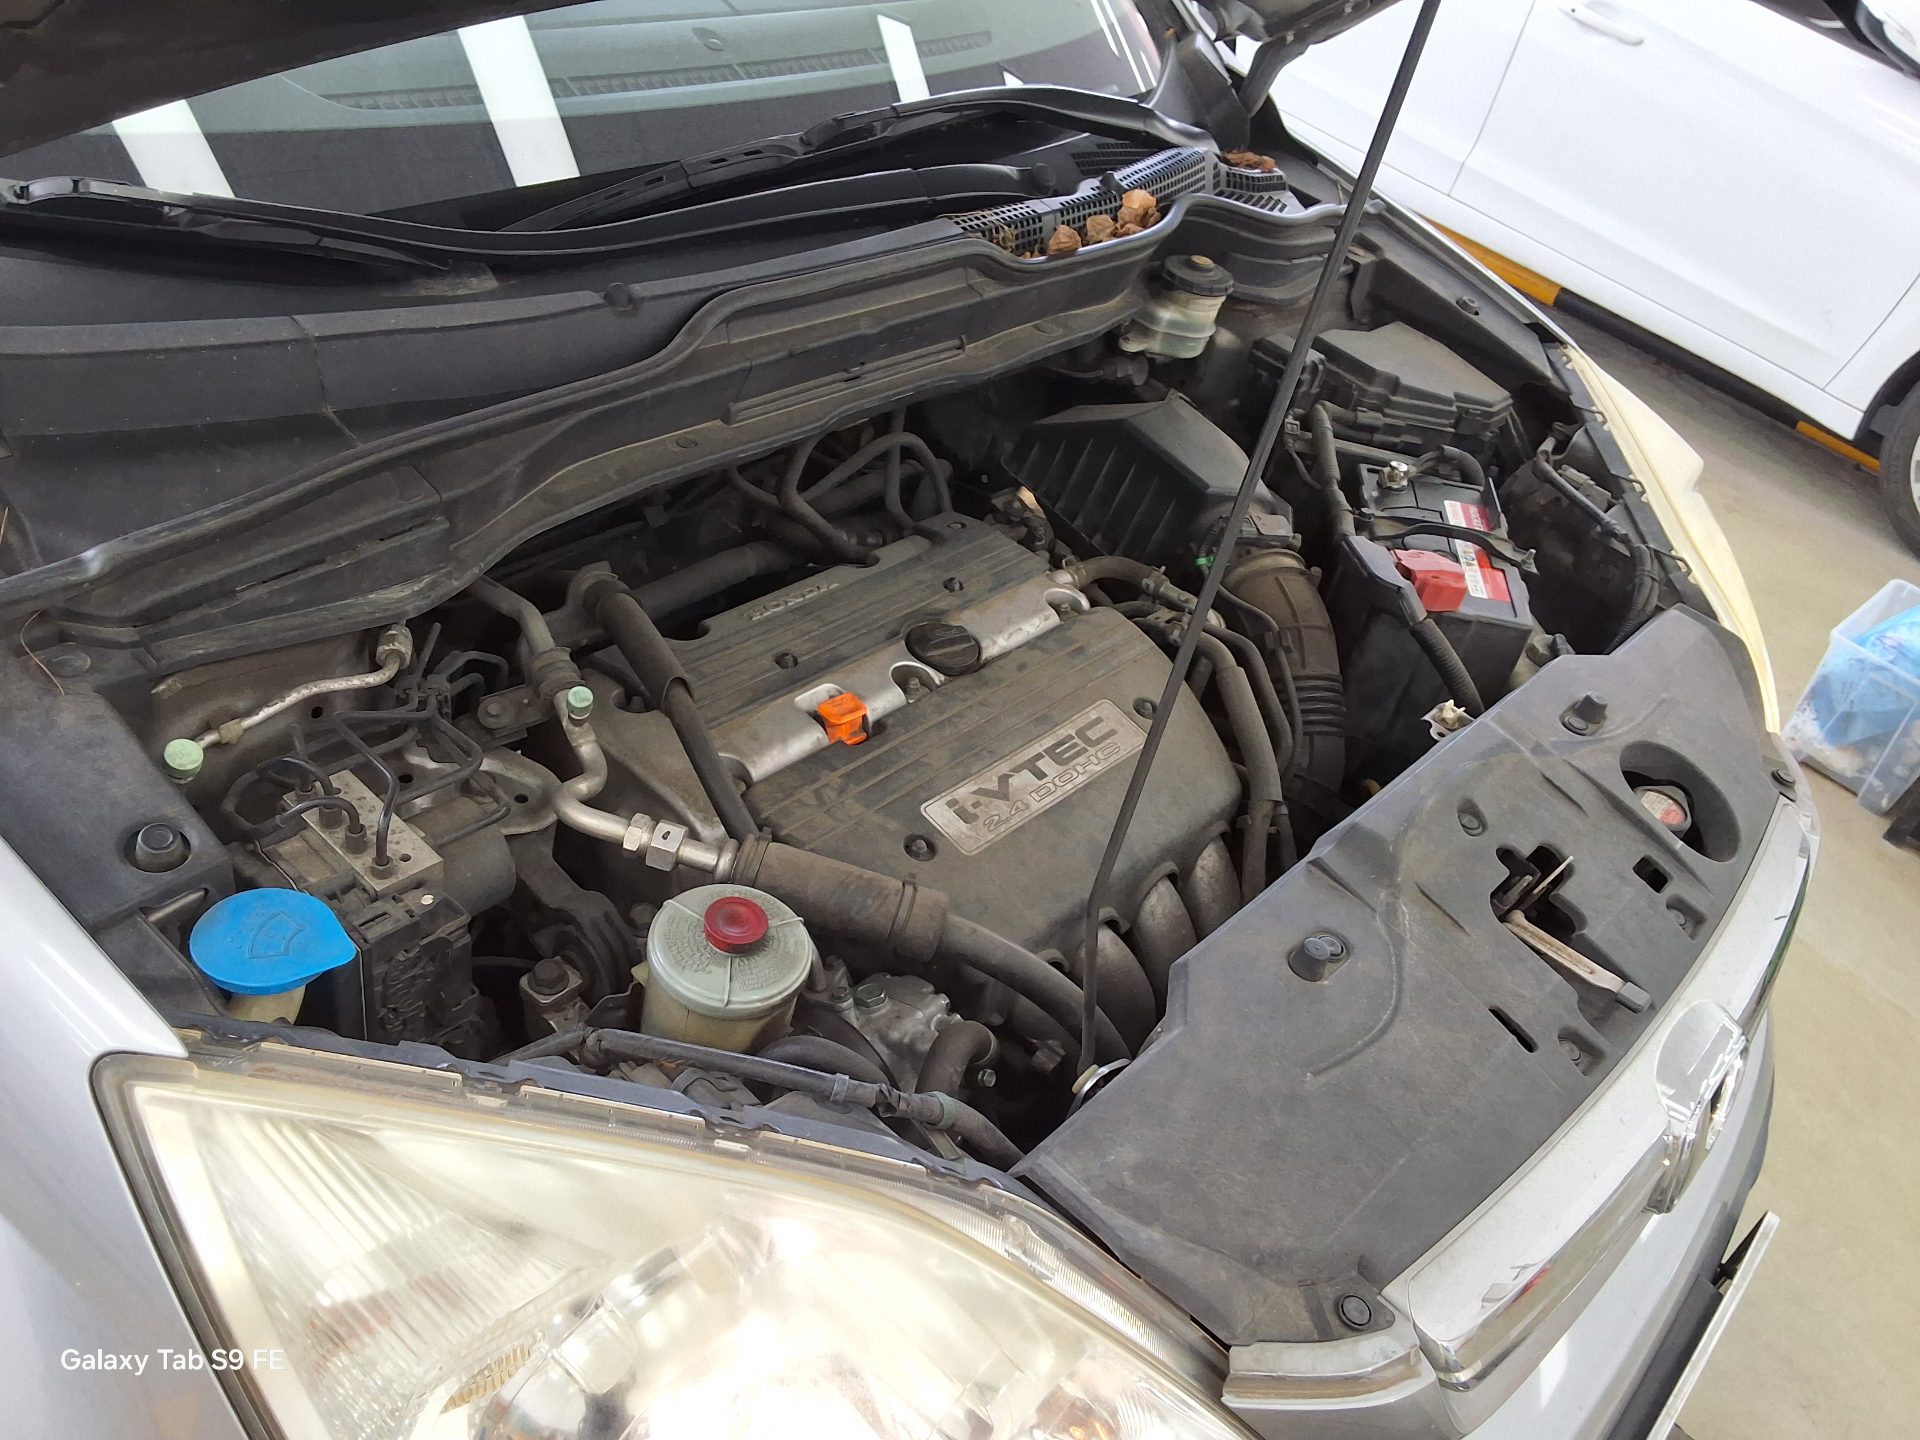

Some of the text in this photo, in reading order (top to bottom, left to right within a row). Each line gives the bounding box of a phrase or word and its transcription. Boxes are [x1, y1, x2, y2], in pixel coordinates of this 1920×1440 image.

[945, 715, 1118, 825] i-VTEC
[982, 741, 1121, 833] 2.4 DOHC
